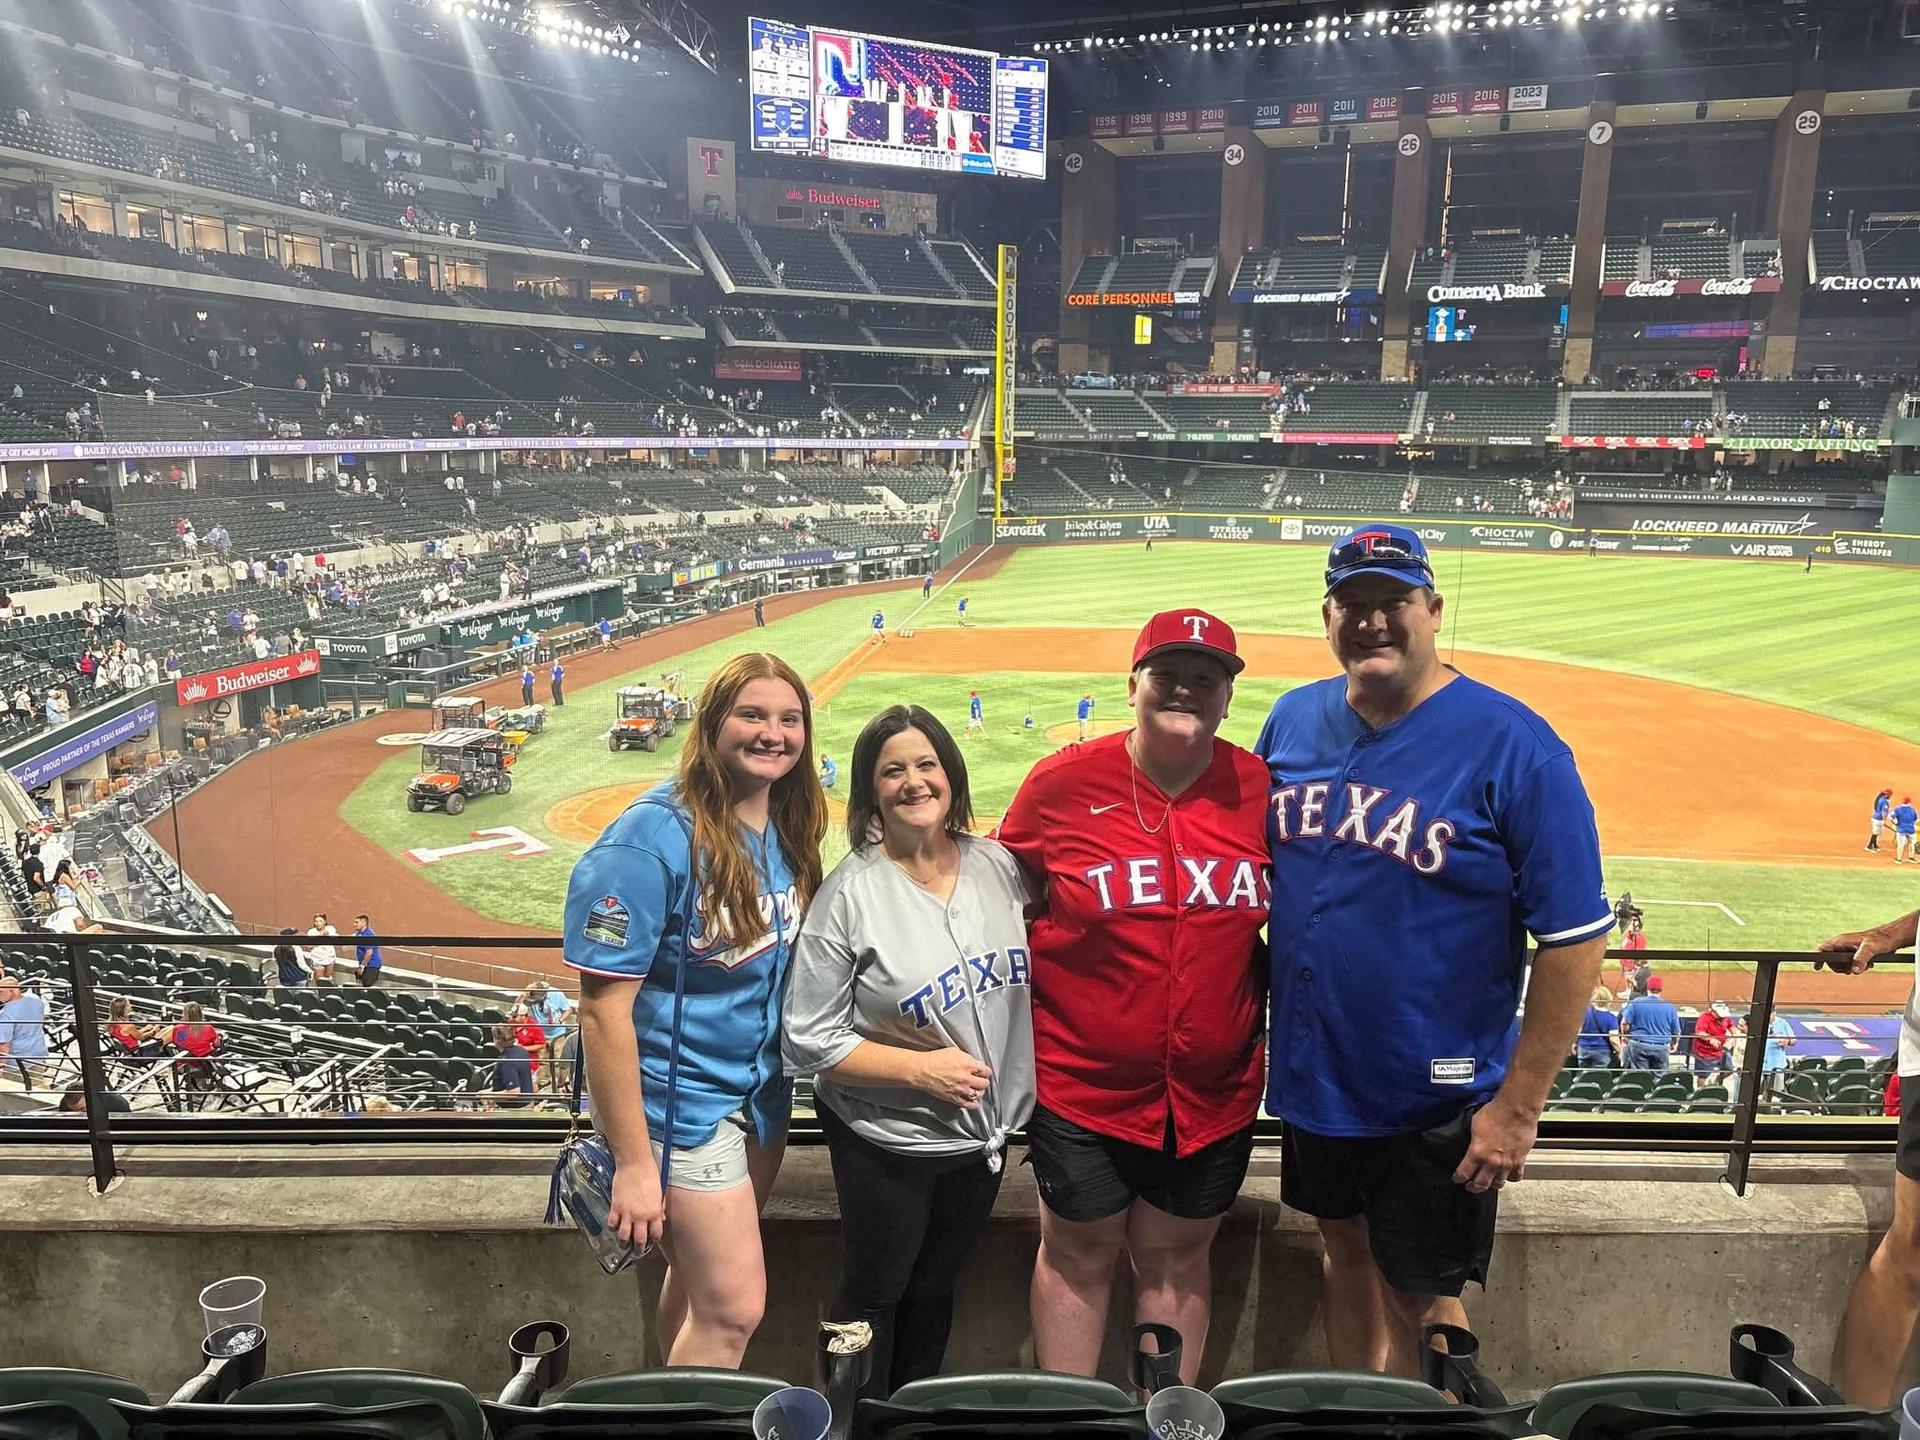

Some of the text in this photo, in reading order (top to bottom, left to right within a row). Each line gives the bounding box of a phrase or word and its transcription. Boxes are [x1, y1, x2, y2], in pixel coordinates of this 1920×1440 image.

[1433, 93, 1457, 104] 2015
[1474, 90, 1499, 101] 2016
[1514, 87, 1542, 98] 2023
[1296, 103, 1317, 114] 2011
[1334, 100, 1355, 111] 2011
[1373, 97, 1396, 109] 2012
[1165, 112, 1187, 122] 1999
[1202, 109, 1224, 120] 2010
[1257, 105, 1279, 116] 2010
[1095, 116, 1117, 126] 1996
[1131, 114, 1152, 124] 1998
[1799, 116, 1818, 130] 29
[1596, 126, 1606, 139] 7
[1401, 138, 1418, 152] 26
[700, 145, 724, 177] T
[1226, 148, 1242, 162] 34
[1066, 157, 1082, 170] 42
[808, 189, 880, 209] Budweiser
[1832, 276, 1920, 290] CHOCTAW
[1503, 283, 1546, 298] Bank
[1068, 291, 1174, 306] CORE PERSONNEL
[1253, 292, 1337, 303] LOCKHEED MARTIN
[1739, 438, 1874, 450] LUXOR STAFFING
[1144, 516, 1170, 529] UTA
[1209, 525, 1253, 533] ESTRELLA
[1632, 519, 1790, 534] LOCKHEED MARTIN
[996, 524, 1047, 538] SEATGEEK
[1304, 524, 1353, 536] TOYOTA
[1477, 527, 1535, 538] CHOCTAW
[1744, 544, 1766, 555] AIR
[1852, 540, 1886, 548] ENERGY
[866, 546, 901, 557] VICTORY
[1850, 548, 1893, 557] TRANSFER
[739, 556, 785, 571] Germania
[508, 610, 531, 631] Kroger
[469, 619, 494, 640] Kroger
[1183, 615, 1209, 641] T
[399, 633, 426, 647] TOYOTA
[332, 644, 367, 653] TOYOTA
[215, 664, 291, 694] Budweiser
[43, 757, 61, 773] PROUD
[61, 746, 84, 764] PARTNER
[101, 730, 116, 744] TEXAS
[115, 721, 136, 737] RANGERS
[1271, 781, 1456, 876] TEXAS
[899, 946, 1031, 1031] TEXA
